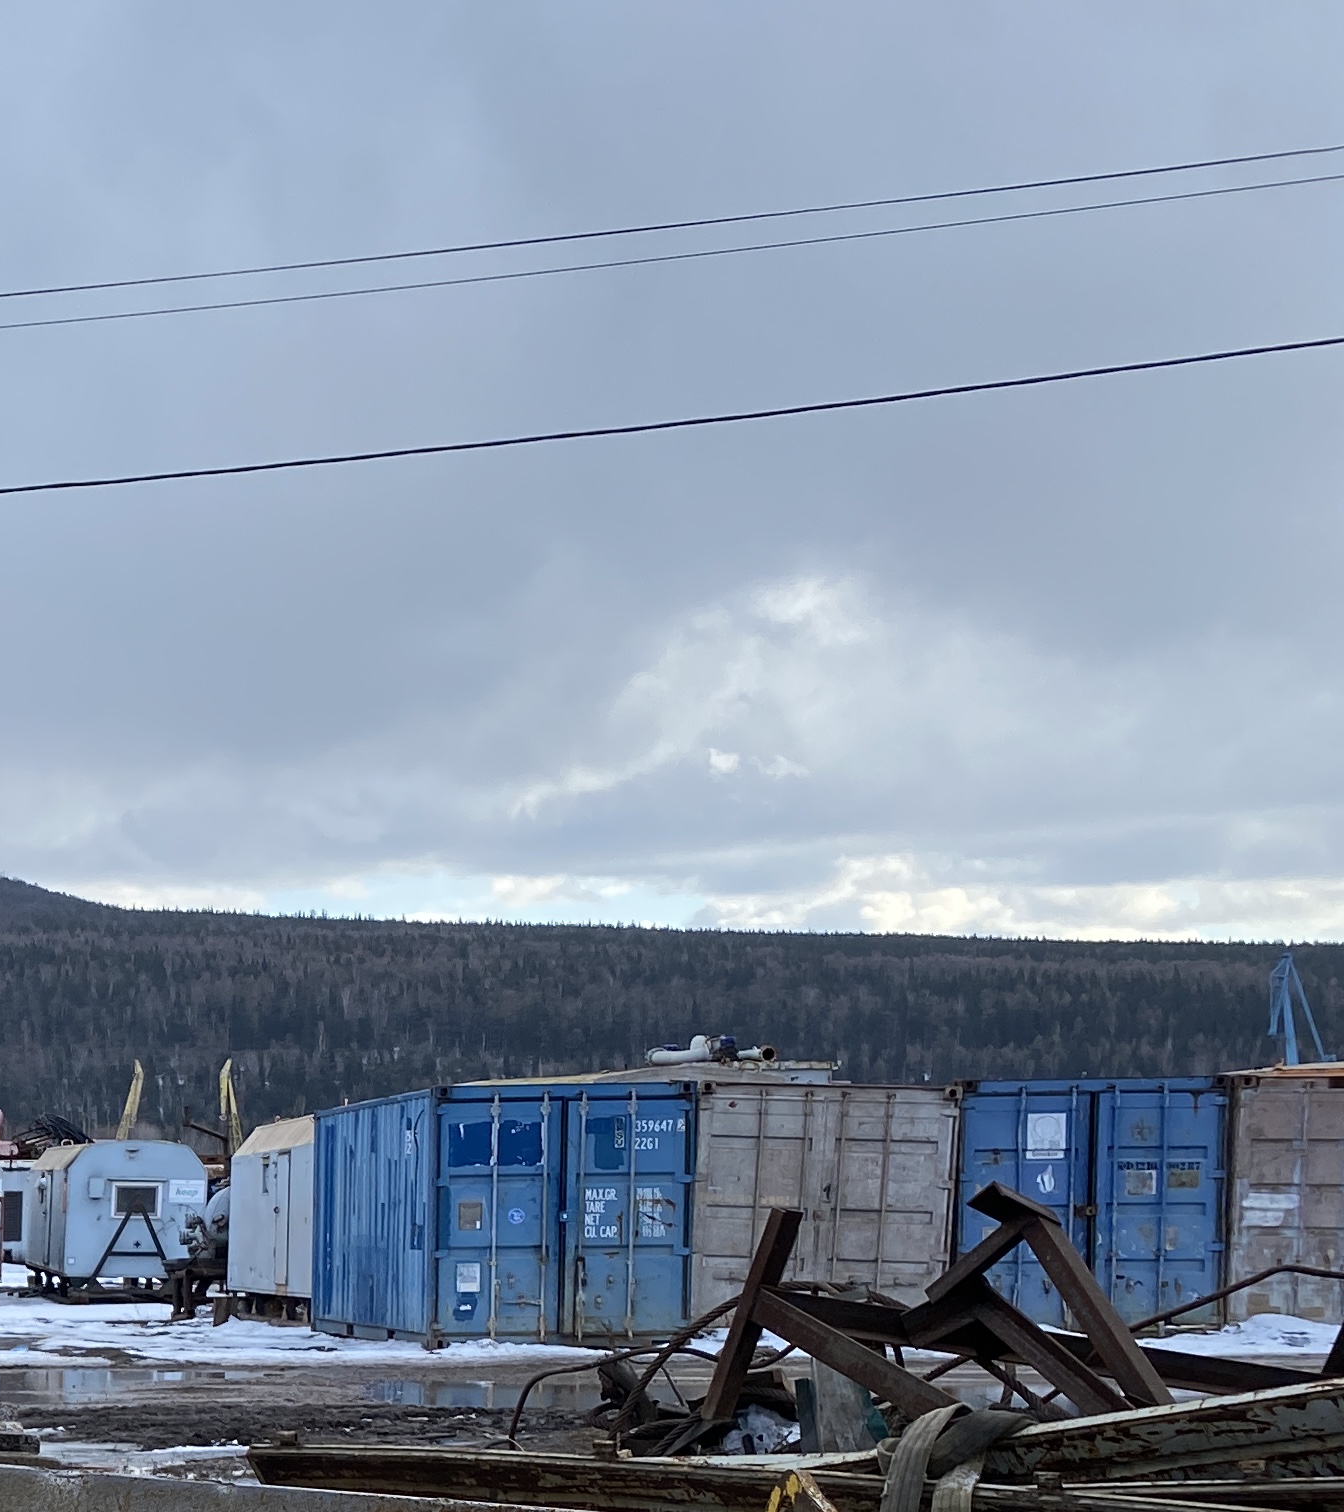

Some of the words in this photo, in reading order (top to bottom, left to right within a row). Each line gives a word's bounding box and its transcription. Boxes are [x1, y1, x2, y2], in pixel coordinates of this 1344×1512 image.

[635, 1119, 673, 1133] 359647
[634, 1137, 659, 1150] 22G1
[586, 1201, 606, 1213] TARE
[584, 1213, 600, 1226] NET
